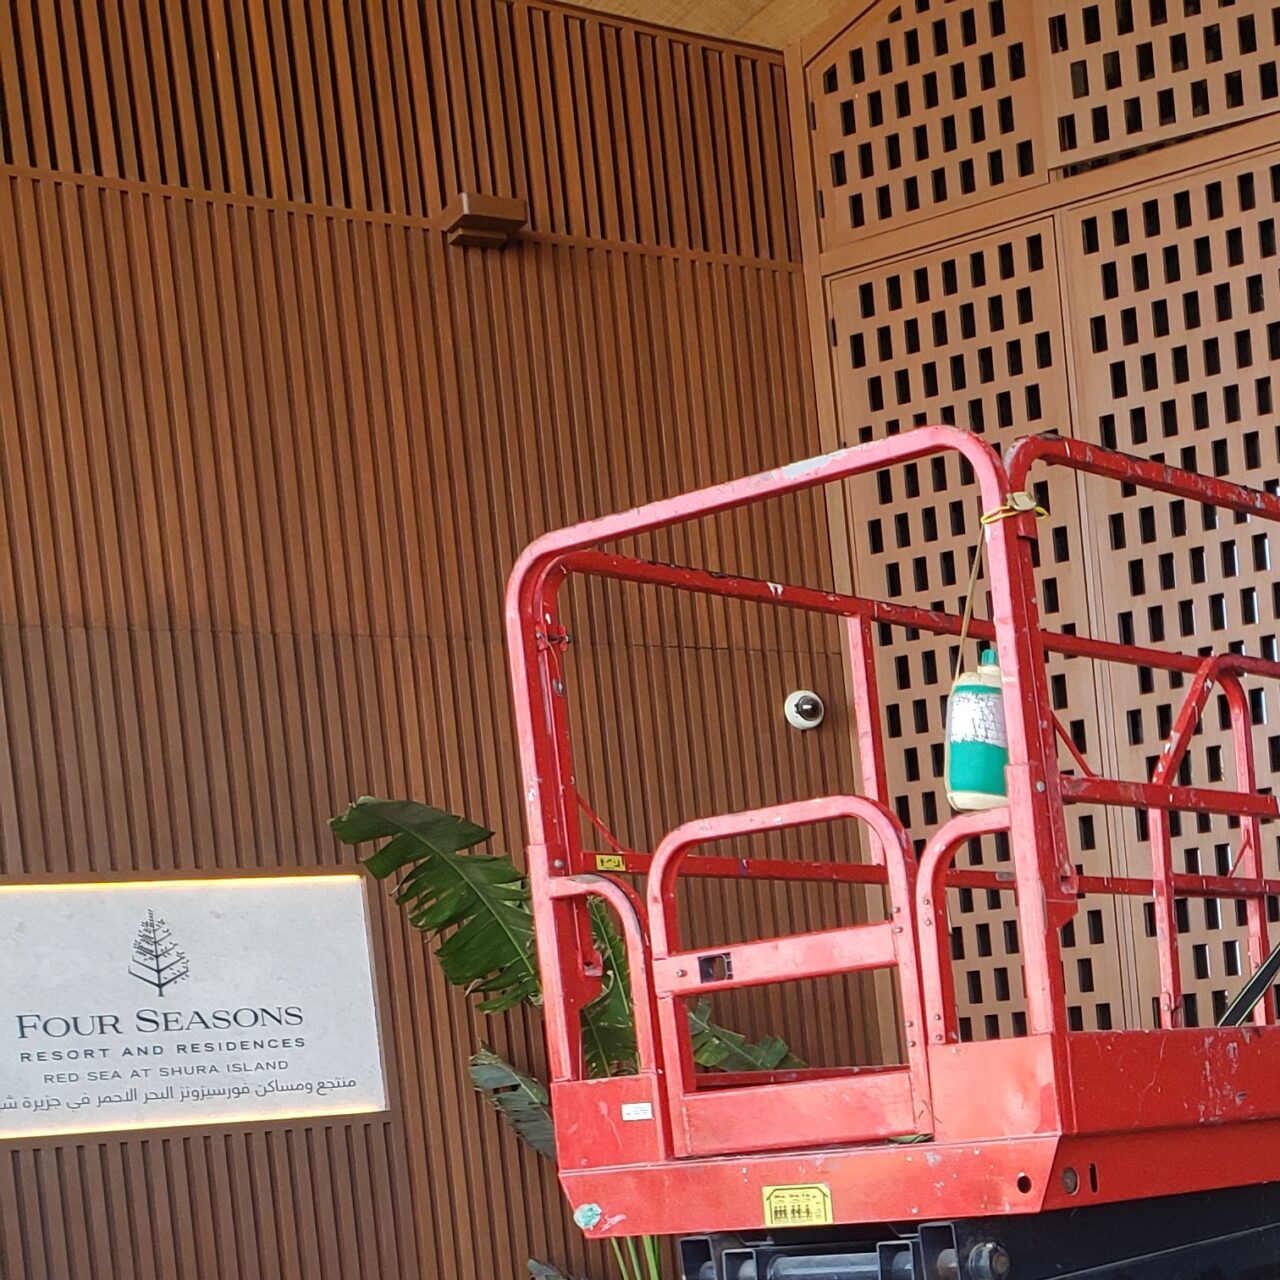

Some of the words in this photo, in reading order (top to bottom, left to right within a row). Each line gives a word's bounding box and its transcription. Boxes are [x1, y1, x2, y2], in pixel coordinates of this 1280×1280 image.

[20, 1048, 110, 1063] RESORT
[121, 1045, 164, 1057] AND
[176, 1037, 306, 1054] RESIDENCES
[44, 1072, 79, 1084] RED
[87, 1070, 122, 1082] SEA
[130, 1068, 152, 1079] AT
[159, 1064, 219, 1077] SHURA
[227, 1060, 289, 1073] ISLAND
[143, 1085, 173, 1104] البحر
[180, 1083, 250, 1102] فورسيزونز
[254, 1079, 313, 1097] ومساكن
[316, 1077, 357, 1096] منتجع
[22, 1093, 61, 1112] جزيرة
